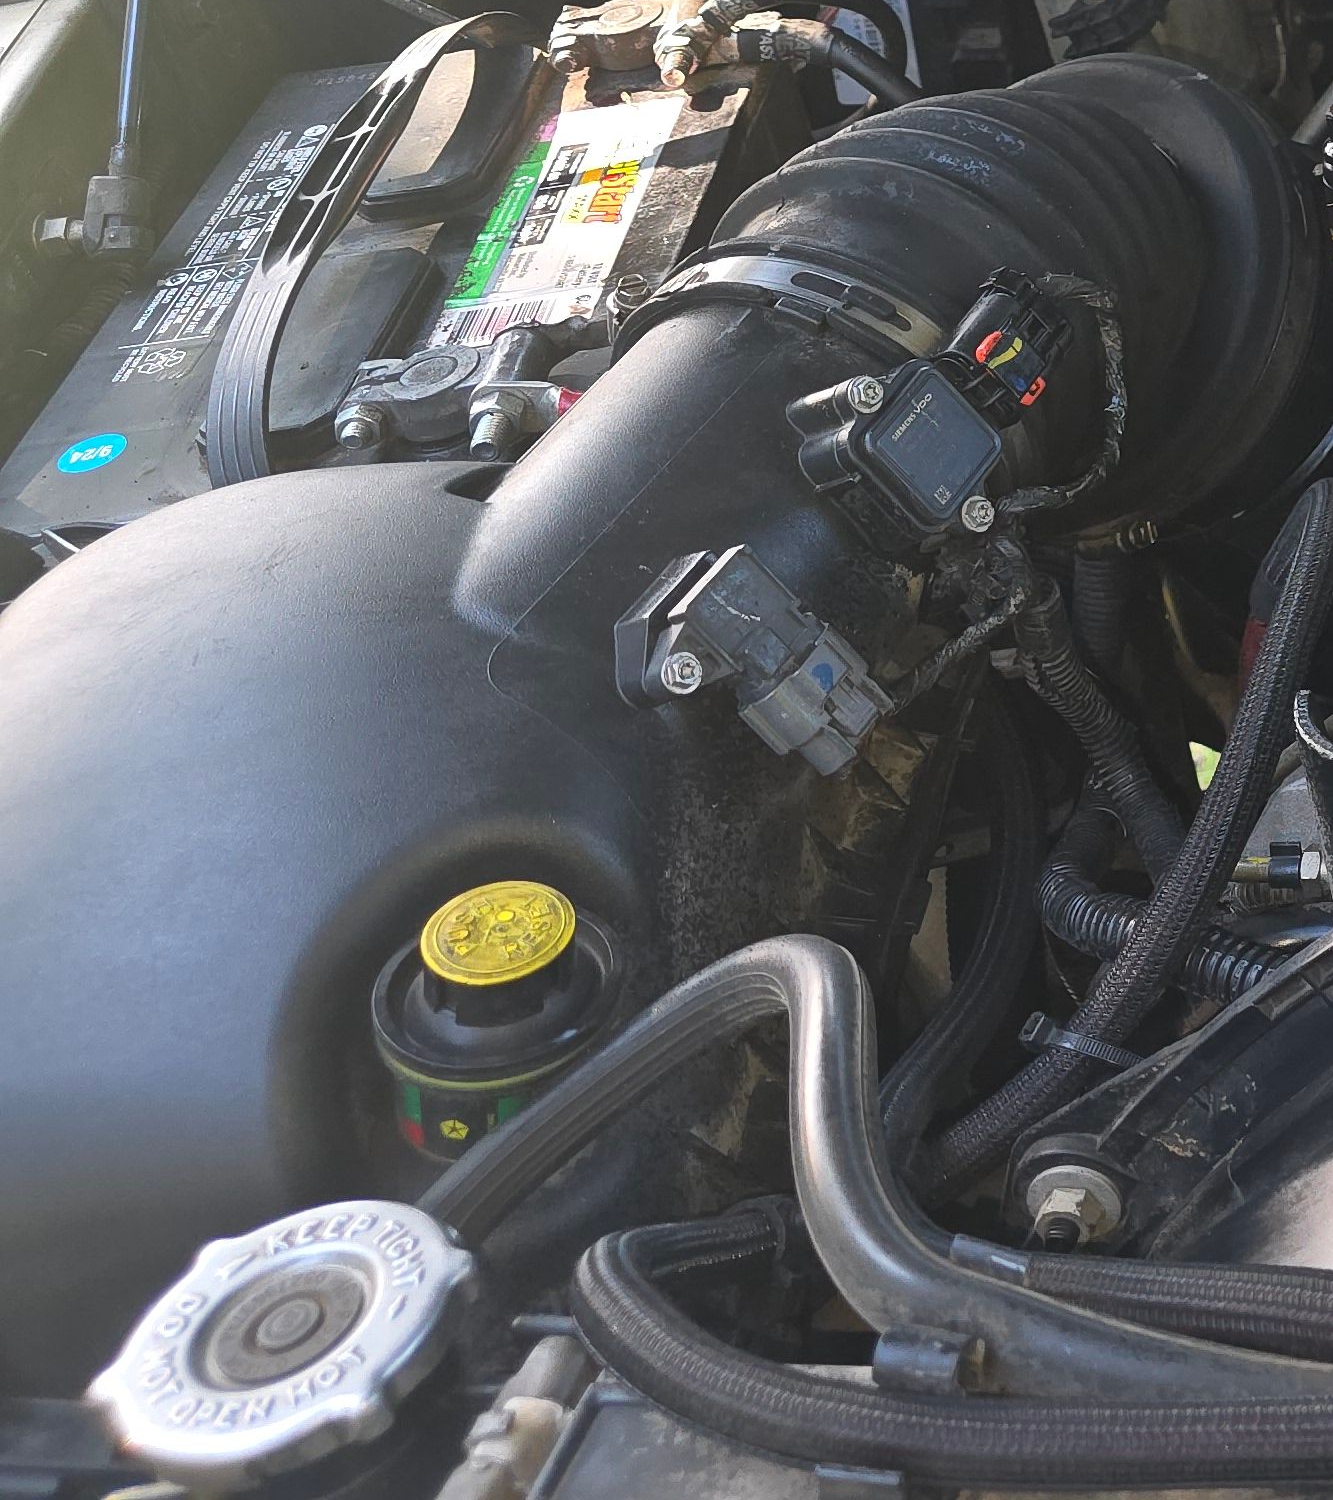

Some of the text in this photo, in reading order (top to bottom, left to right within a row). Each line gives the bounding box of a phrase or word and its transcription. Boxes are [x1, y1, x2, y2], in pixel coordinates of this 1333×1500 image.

[892, 392, 933, 442] SIEMENS VDO
[69, 444, 114, 464] 9/24
[265, 1211, 427, 1287] KEEP TIGHT
